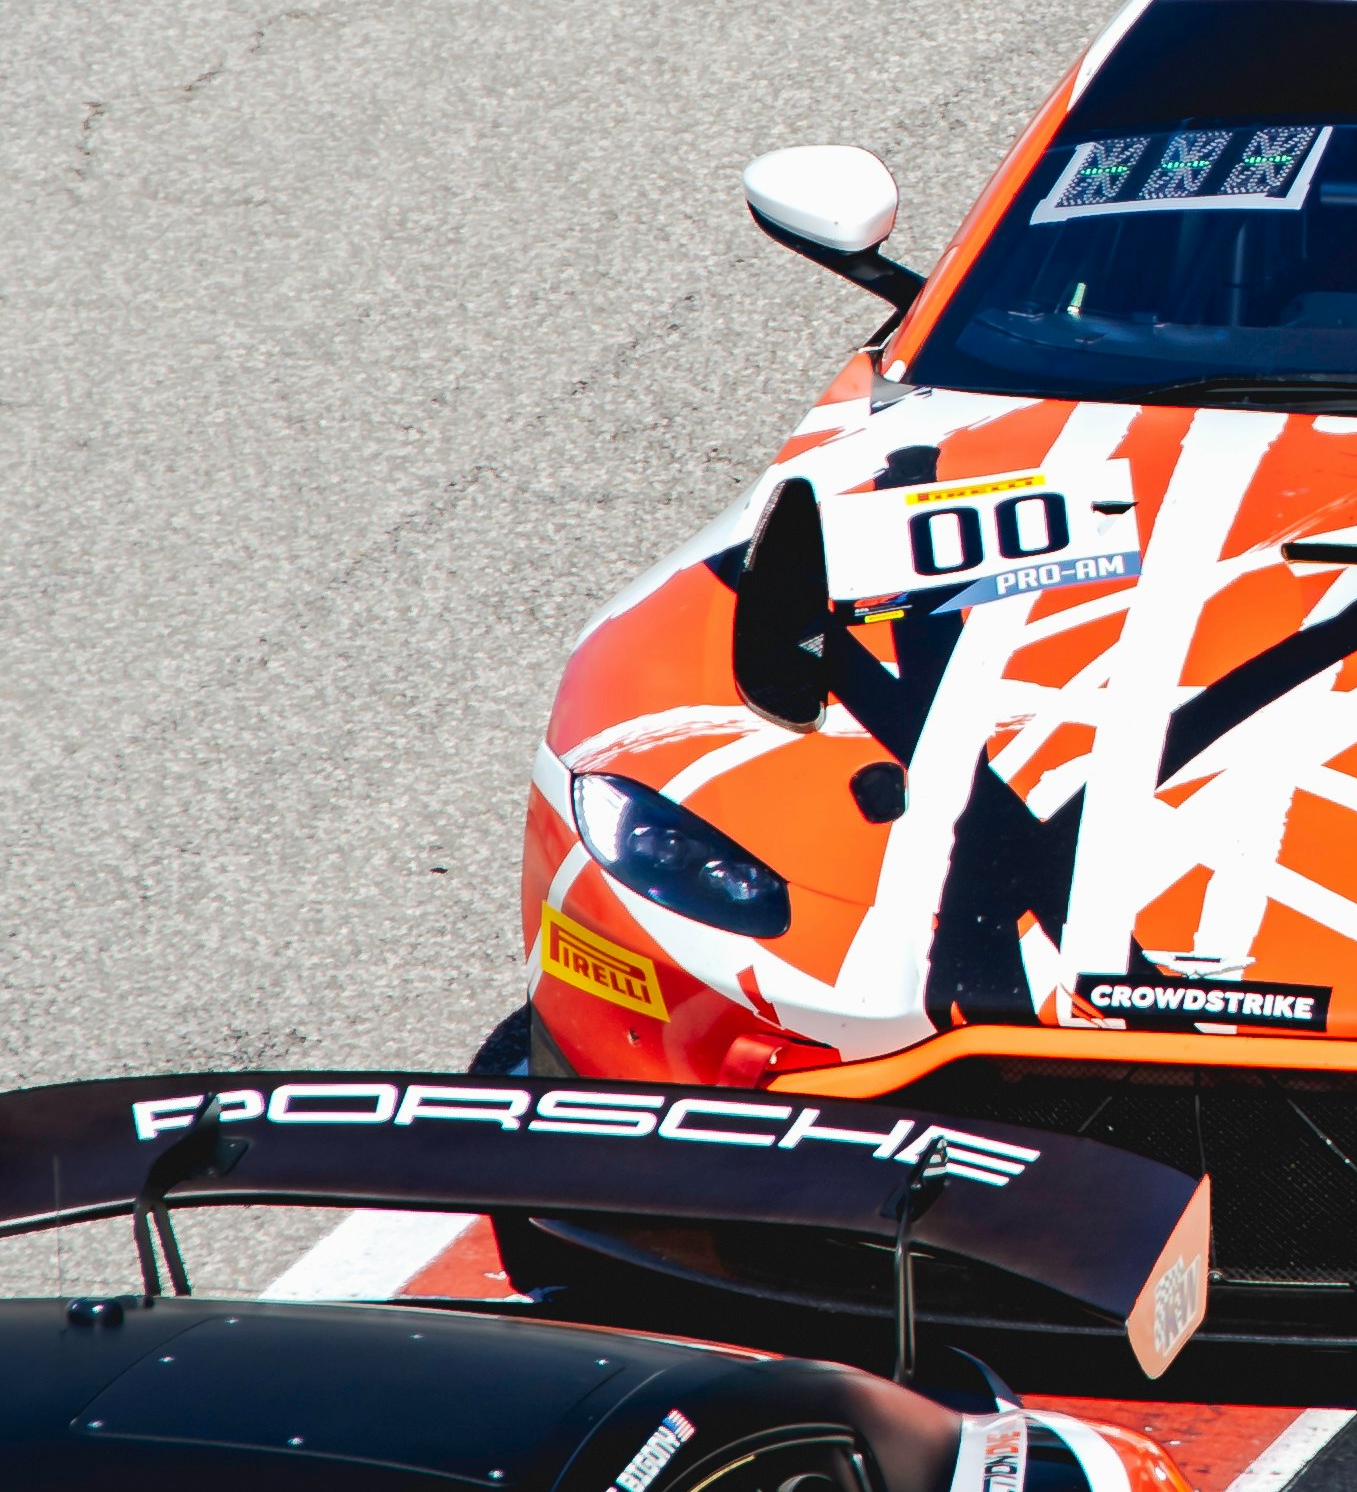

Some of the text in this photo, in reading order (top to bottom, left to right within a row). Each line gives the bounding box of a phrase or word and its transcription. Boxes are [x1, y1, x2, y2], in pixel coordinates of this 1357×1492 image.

[906, 490, 1071, 577] 00
[995, 554, 1126, 597] PRO-AM
[549, 925, 652, 1006] PIRELLI
[1089, 983, 1316, 1020] CROWDSTRIKE
[132, 1083, 1041, 1187] PORSCHE
